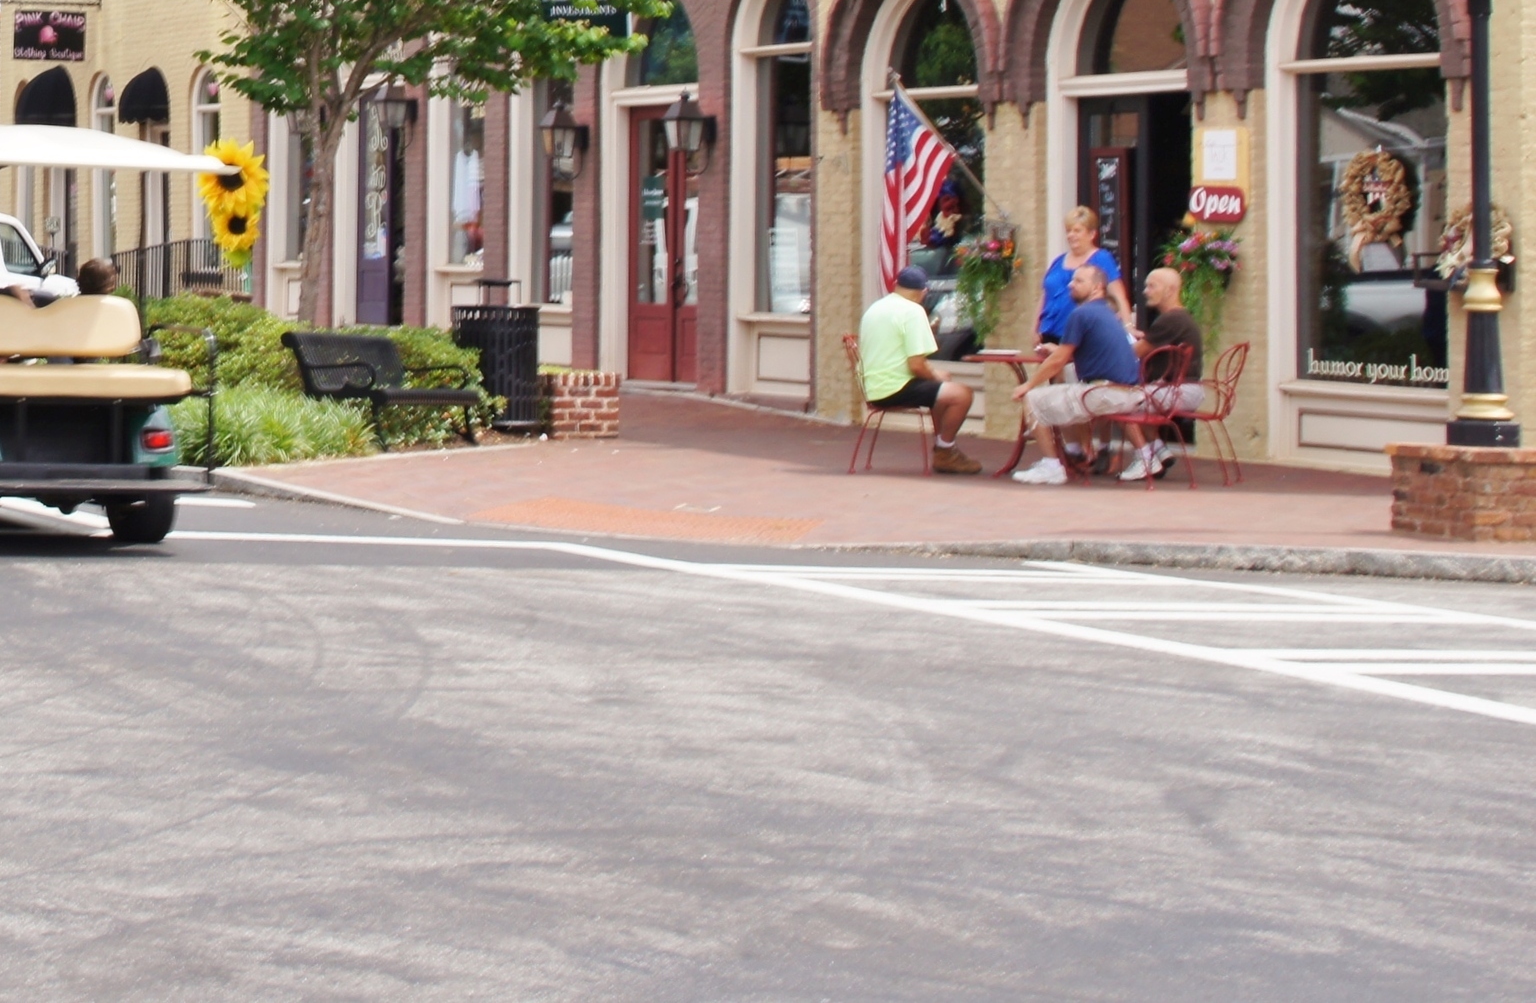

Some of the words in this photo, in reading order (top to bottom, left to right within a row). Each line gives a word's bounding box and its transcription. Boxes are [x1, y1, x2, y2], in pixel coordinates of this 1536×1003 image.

[15, 11, 43, 26] PINK
[14, 47, 46, 59] Clothing
[1189, 187, 1241, 220] Open
[1307, 348, 1364, 377] humor
[1366, 363, 1407, 384] your
